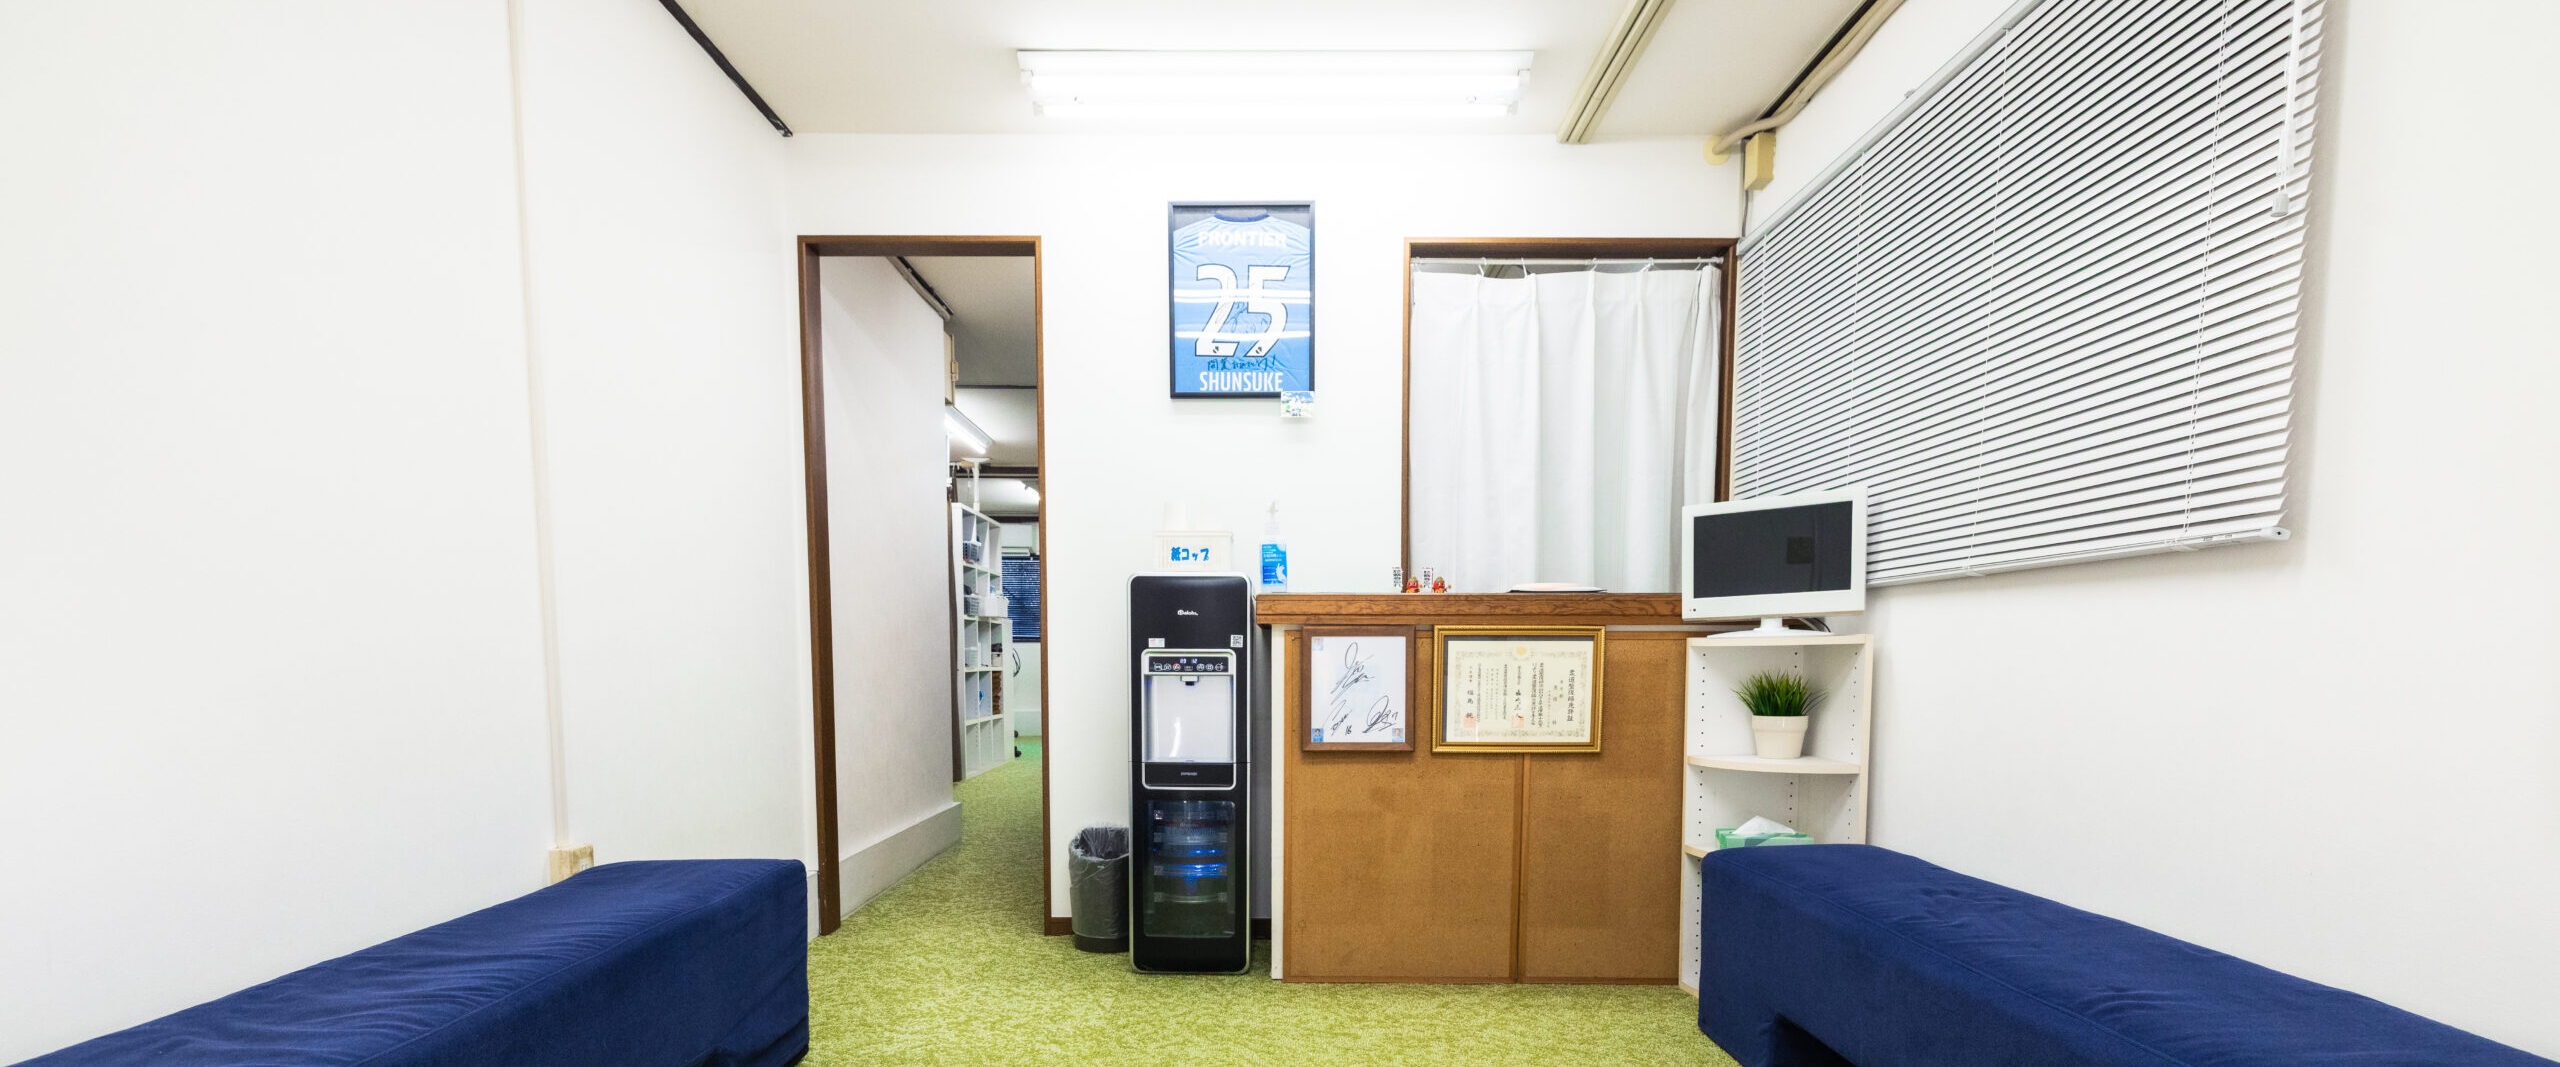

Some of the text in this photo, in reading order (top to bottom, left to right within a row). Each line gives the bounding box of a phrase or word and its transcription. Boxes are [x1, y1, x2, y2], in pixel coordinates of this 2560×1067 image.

[1198, 231, 1287, 247] FRONTIER
[1195, 263, 1292, 358] 25
[1200, 371, 1284, 391] SHUNSUKE
[1171, 547, 1210, 561] 紙コップ
